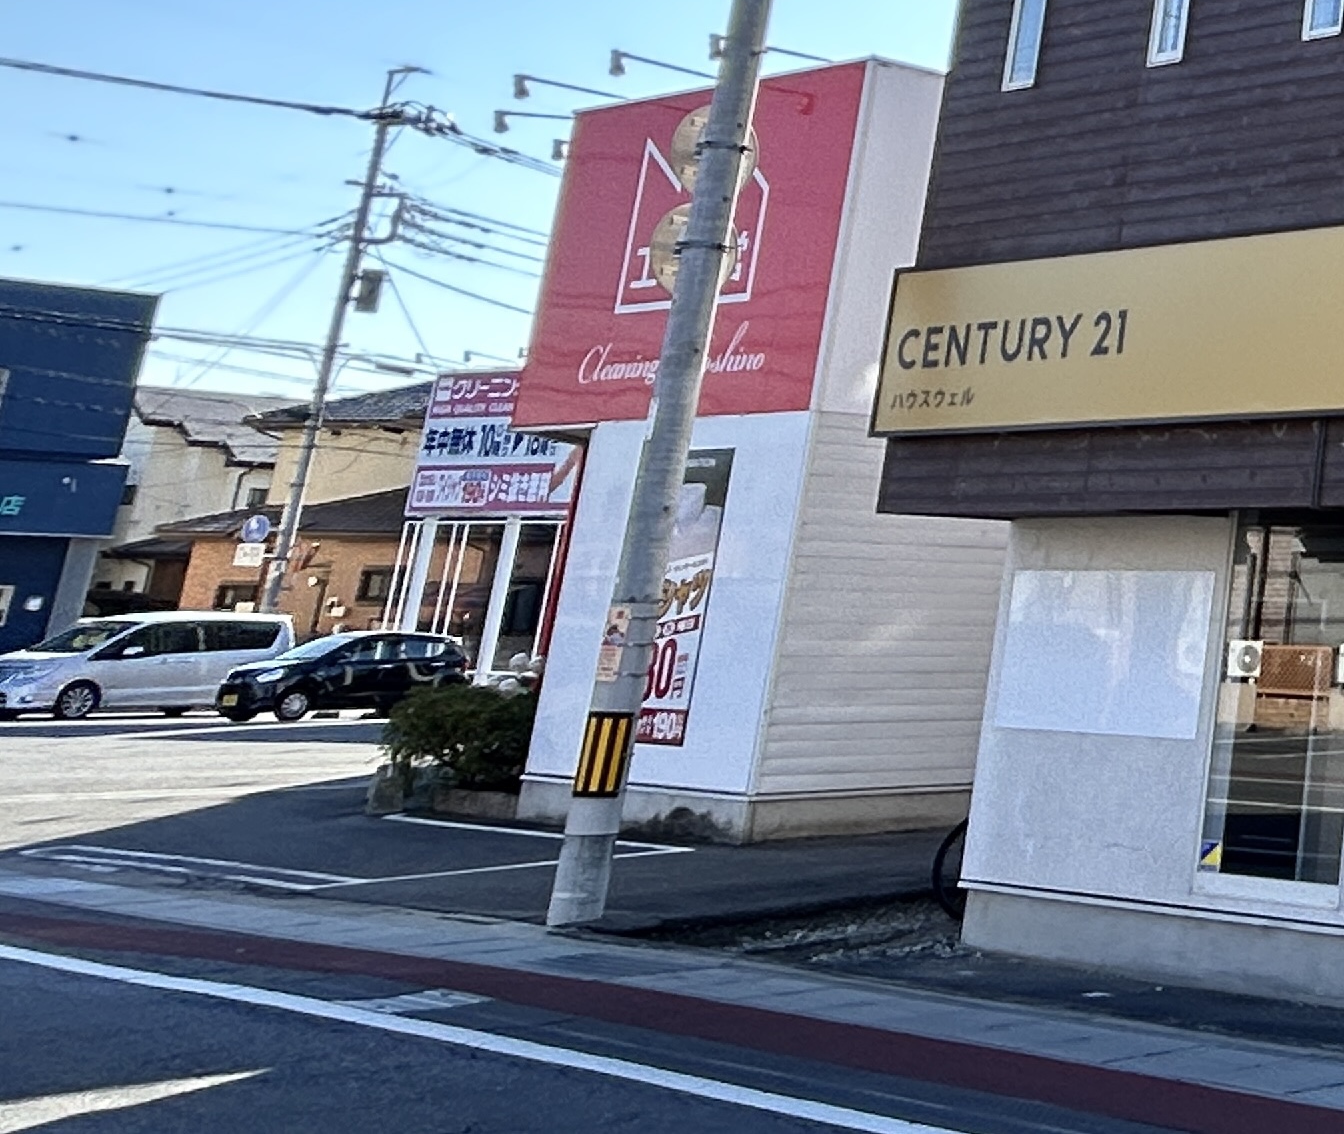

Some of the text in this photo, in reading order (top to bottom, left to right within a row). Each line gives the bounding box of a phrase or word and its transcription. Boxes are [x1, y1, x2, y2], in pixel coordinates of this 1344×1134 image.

[898, 309, 1129, 370] CENTURY 21
[578, 342, 661, 385] Cleaning
[453, 377, 521, 399] クリーニン
[891, 387, 975, 410] ハウスウェル
